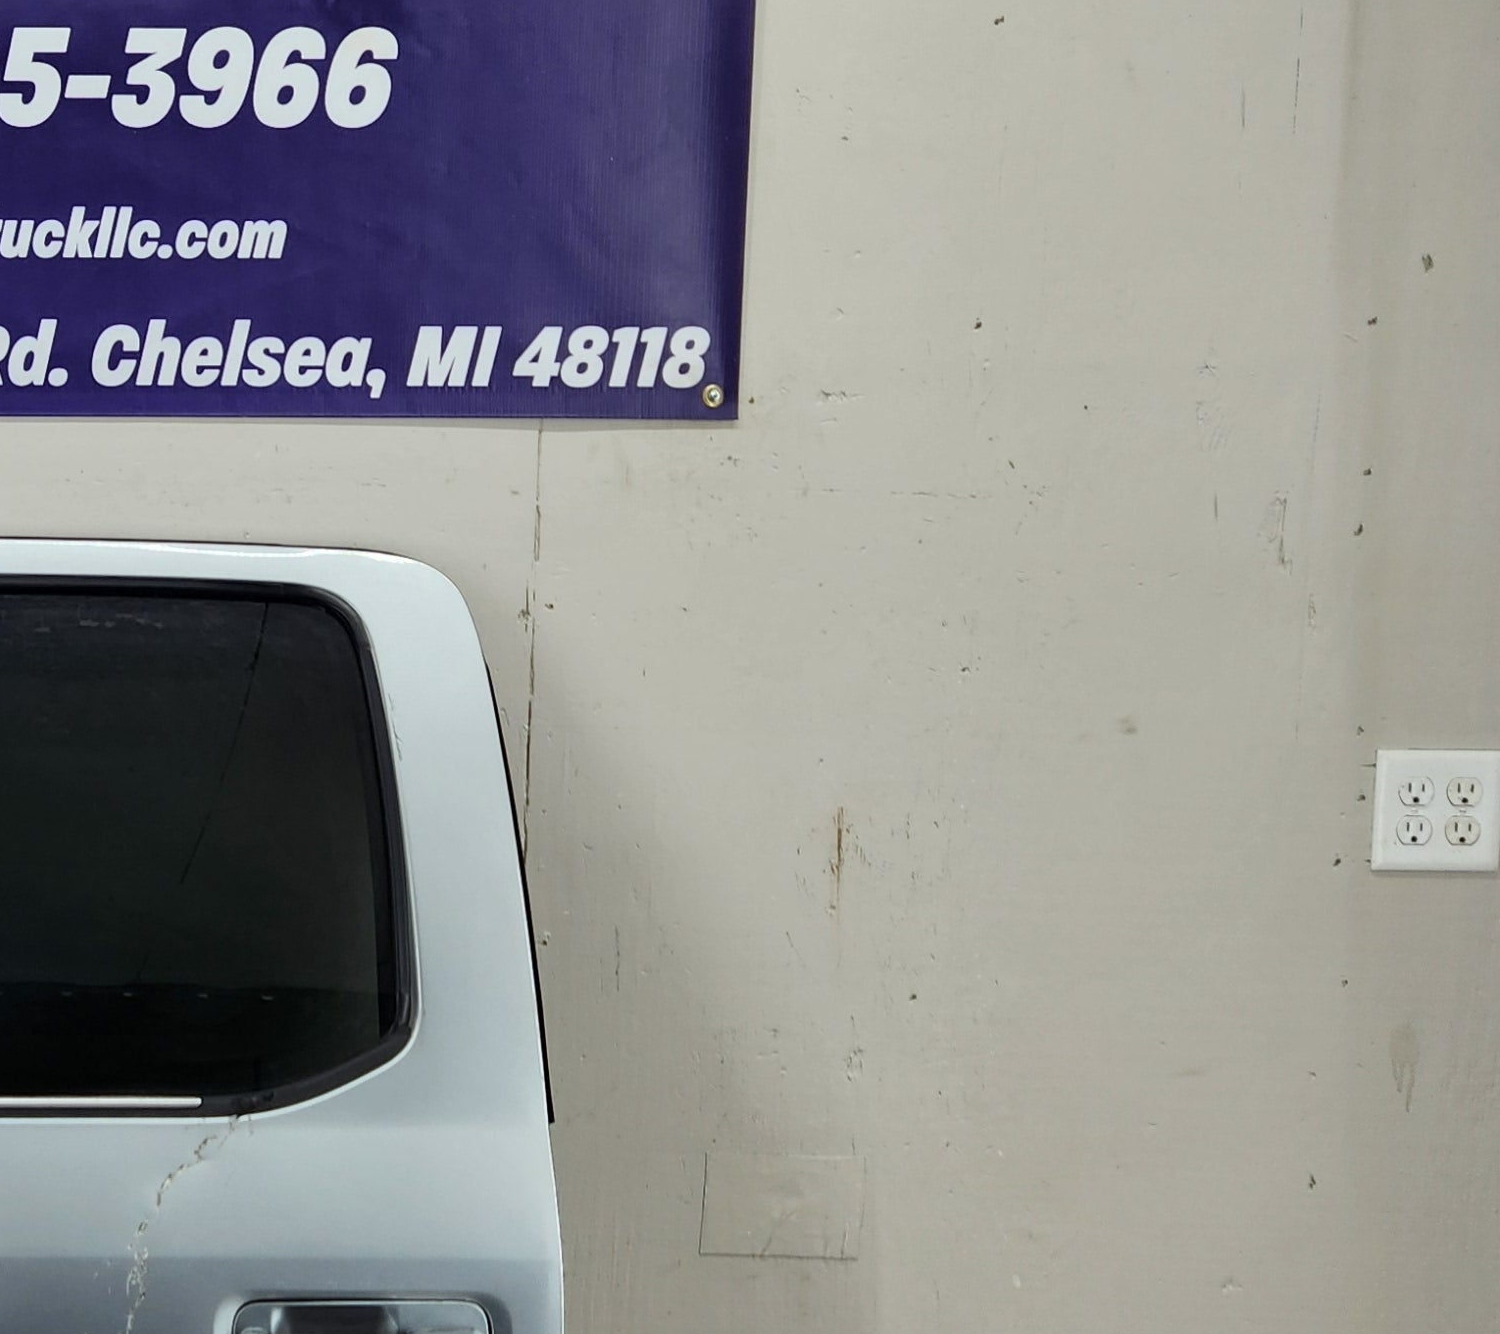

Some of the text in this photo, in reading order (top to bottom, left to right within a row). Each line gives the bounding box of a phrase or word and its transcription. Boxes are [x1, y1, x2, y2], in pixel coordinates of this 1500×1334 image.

[91, 319, 386, 399] Chelsea,
[406, 325, 503, 387] MI
[512, 325, 711, 389] 48118
